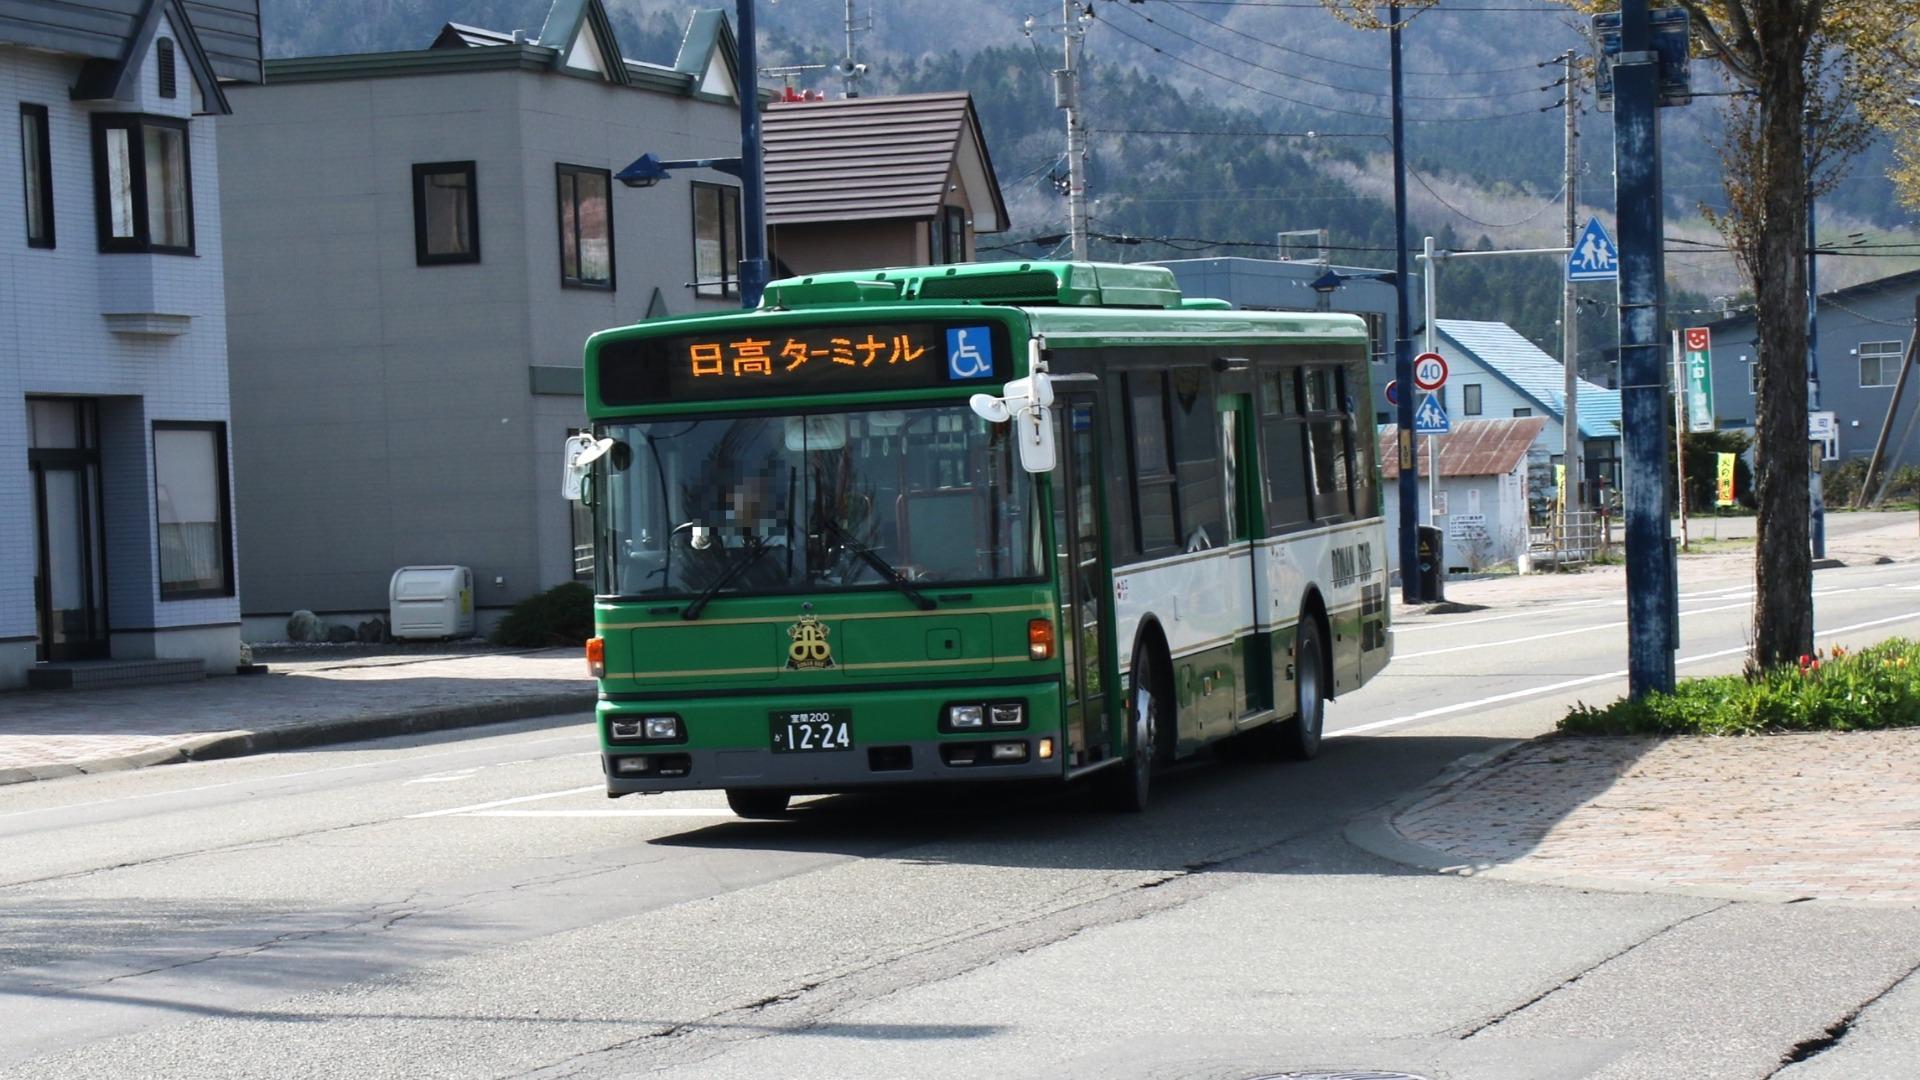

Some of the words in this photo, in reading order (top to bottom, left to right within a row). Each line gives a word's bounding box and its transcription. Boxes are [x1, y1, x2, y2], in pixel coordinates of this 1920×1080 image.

[689, 334, 926, 377] 日高ターミナル
[1420, 364, 1440, 380] 40
[787, 722, 850, 750] 12-24
